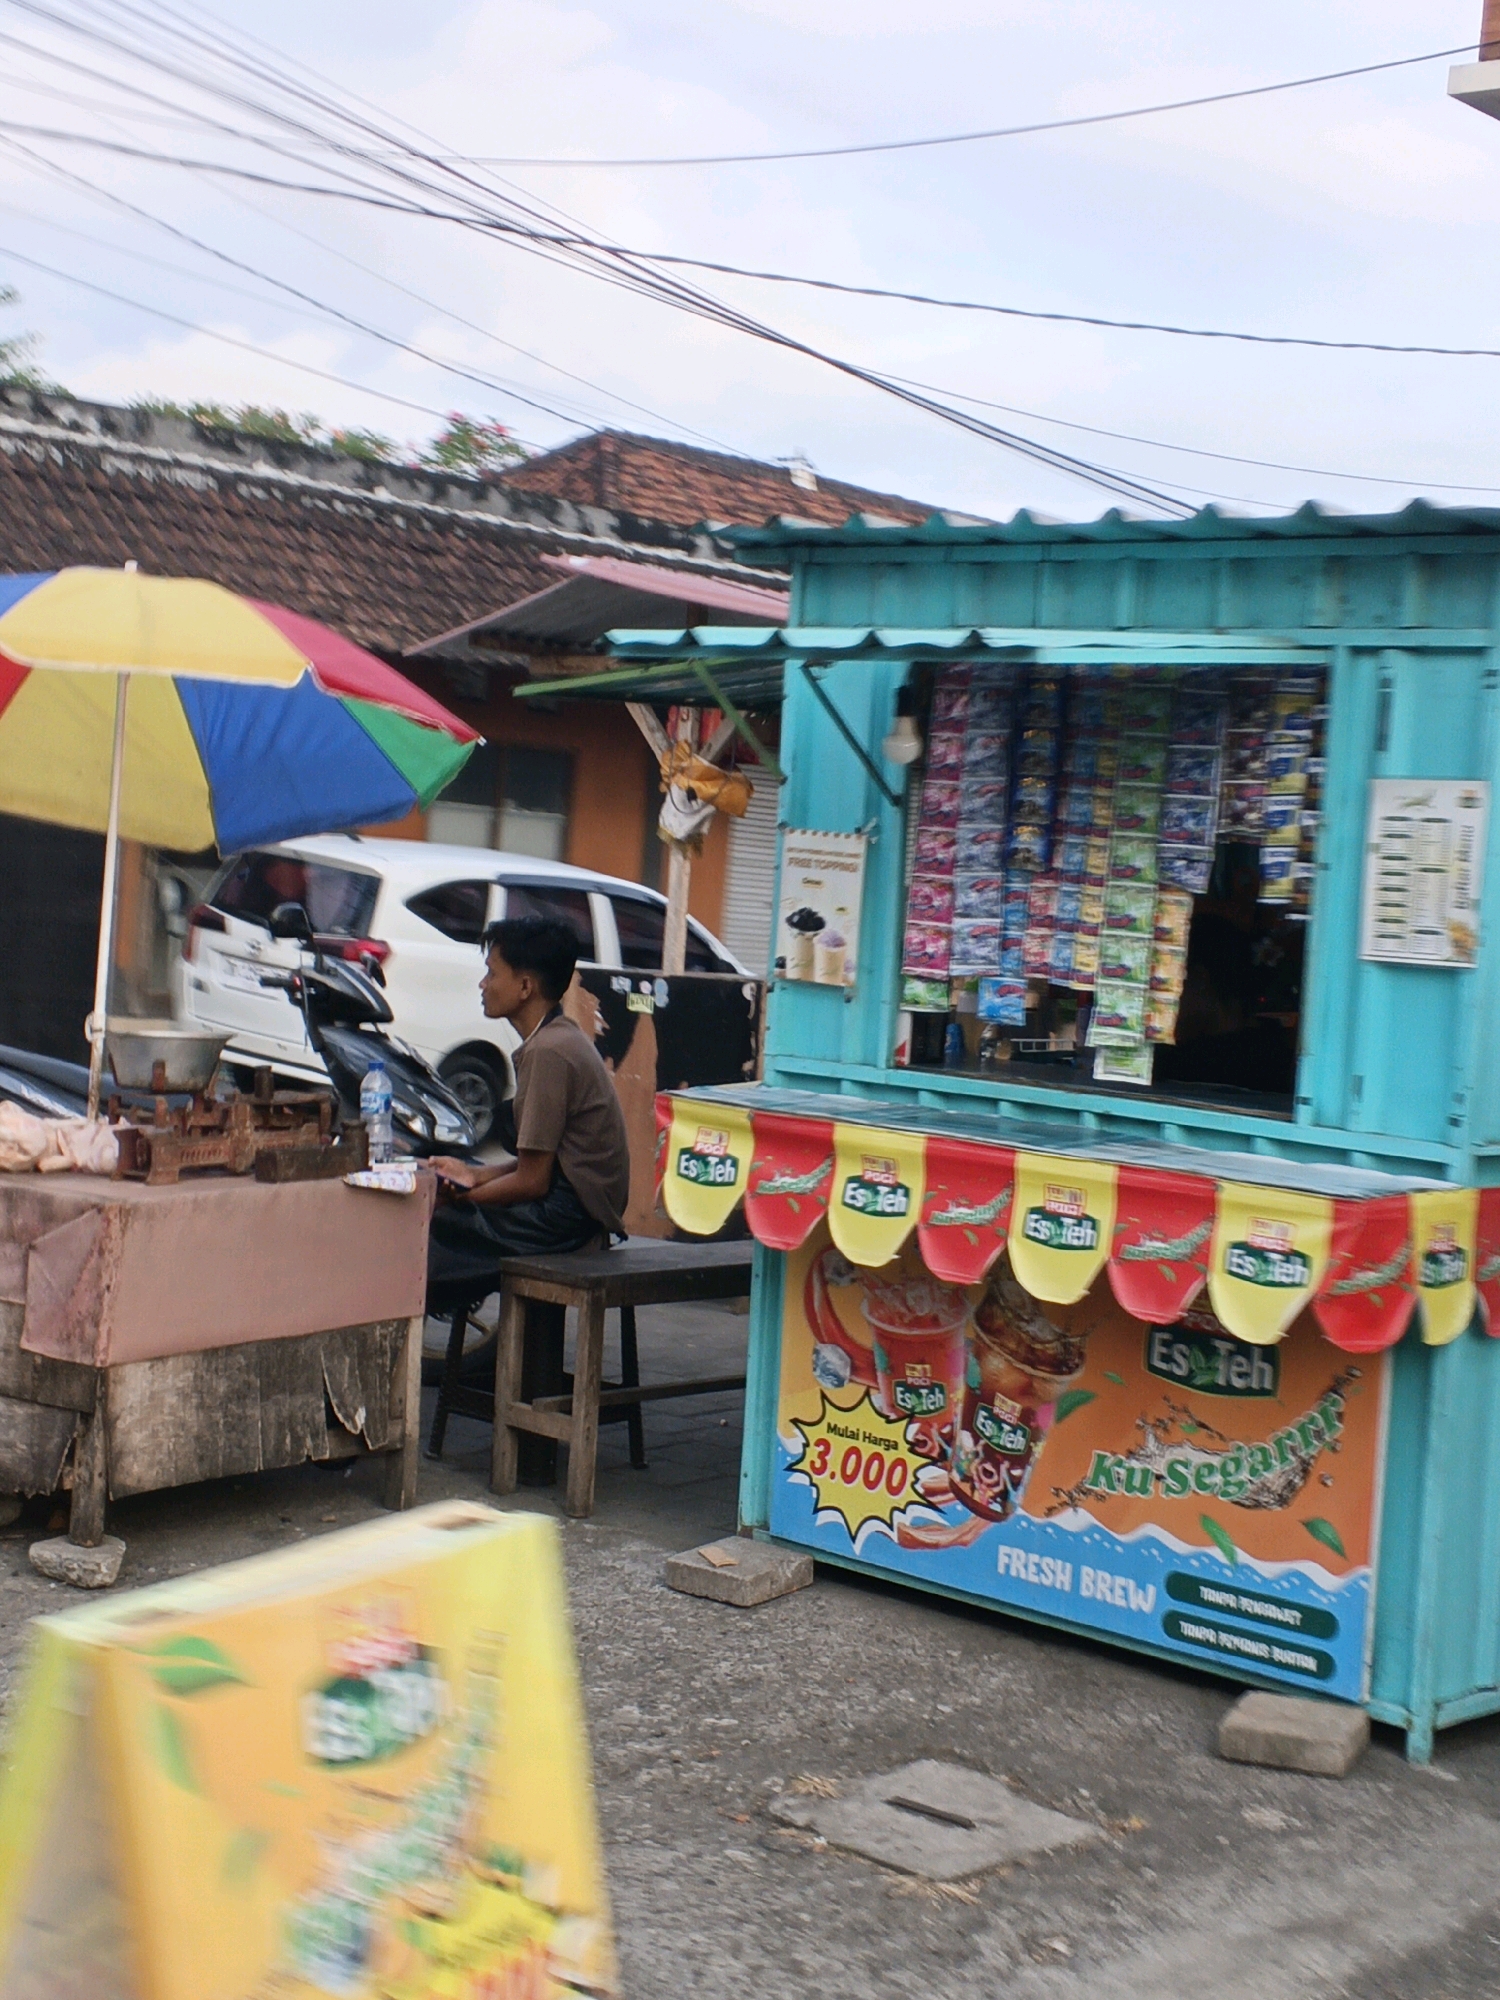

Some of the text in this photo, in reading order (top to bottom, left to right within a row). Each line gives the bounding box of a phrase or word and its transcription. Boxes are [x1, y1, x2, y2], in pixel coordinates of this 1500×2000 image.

[787, 856, 812, 869] FREE
[695, 1142, 725, 1155] POCI
[680, 1155, 698, 1178] Es
[706, 1156, 737, 1183] Teh
[863, 1170, 896, 1185] POCI
[844, 1183, 867, 1207] Es
[876, 1186, 908, 1213] Teh
[1025, 1214, 1050, 1240] Es
[1060, 1217, 1097, 1247] Teh
[1227, 1248, 1256, 1277] Es
[1185, 1310, 1230, 1335] PO
[1150, 1331, 1273, 1391] Es Teh
[906, 1376, 931, 1386] POCI
[896, 1386, 944, 1411] Es Teh
[827, 1422, 899, 1451] Mulai Harga
[976, 1410, 1027, 1450] Es Teh
[1085, 1392, 1346, 1500] Ku Segarrr
[809, 1437, 909, 1497] 3.000
[997, 1545, 1158, 1614] FRESH BREW
